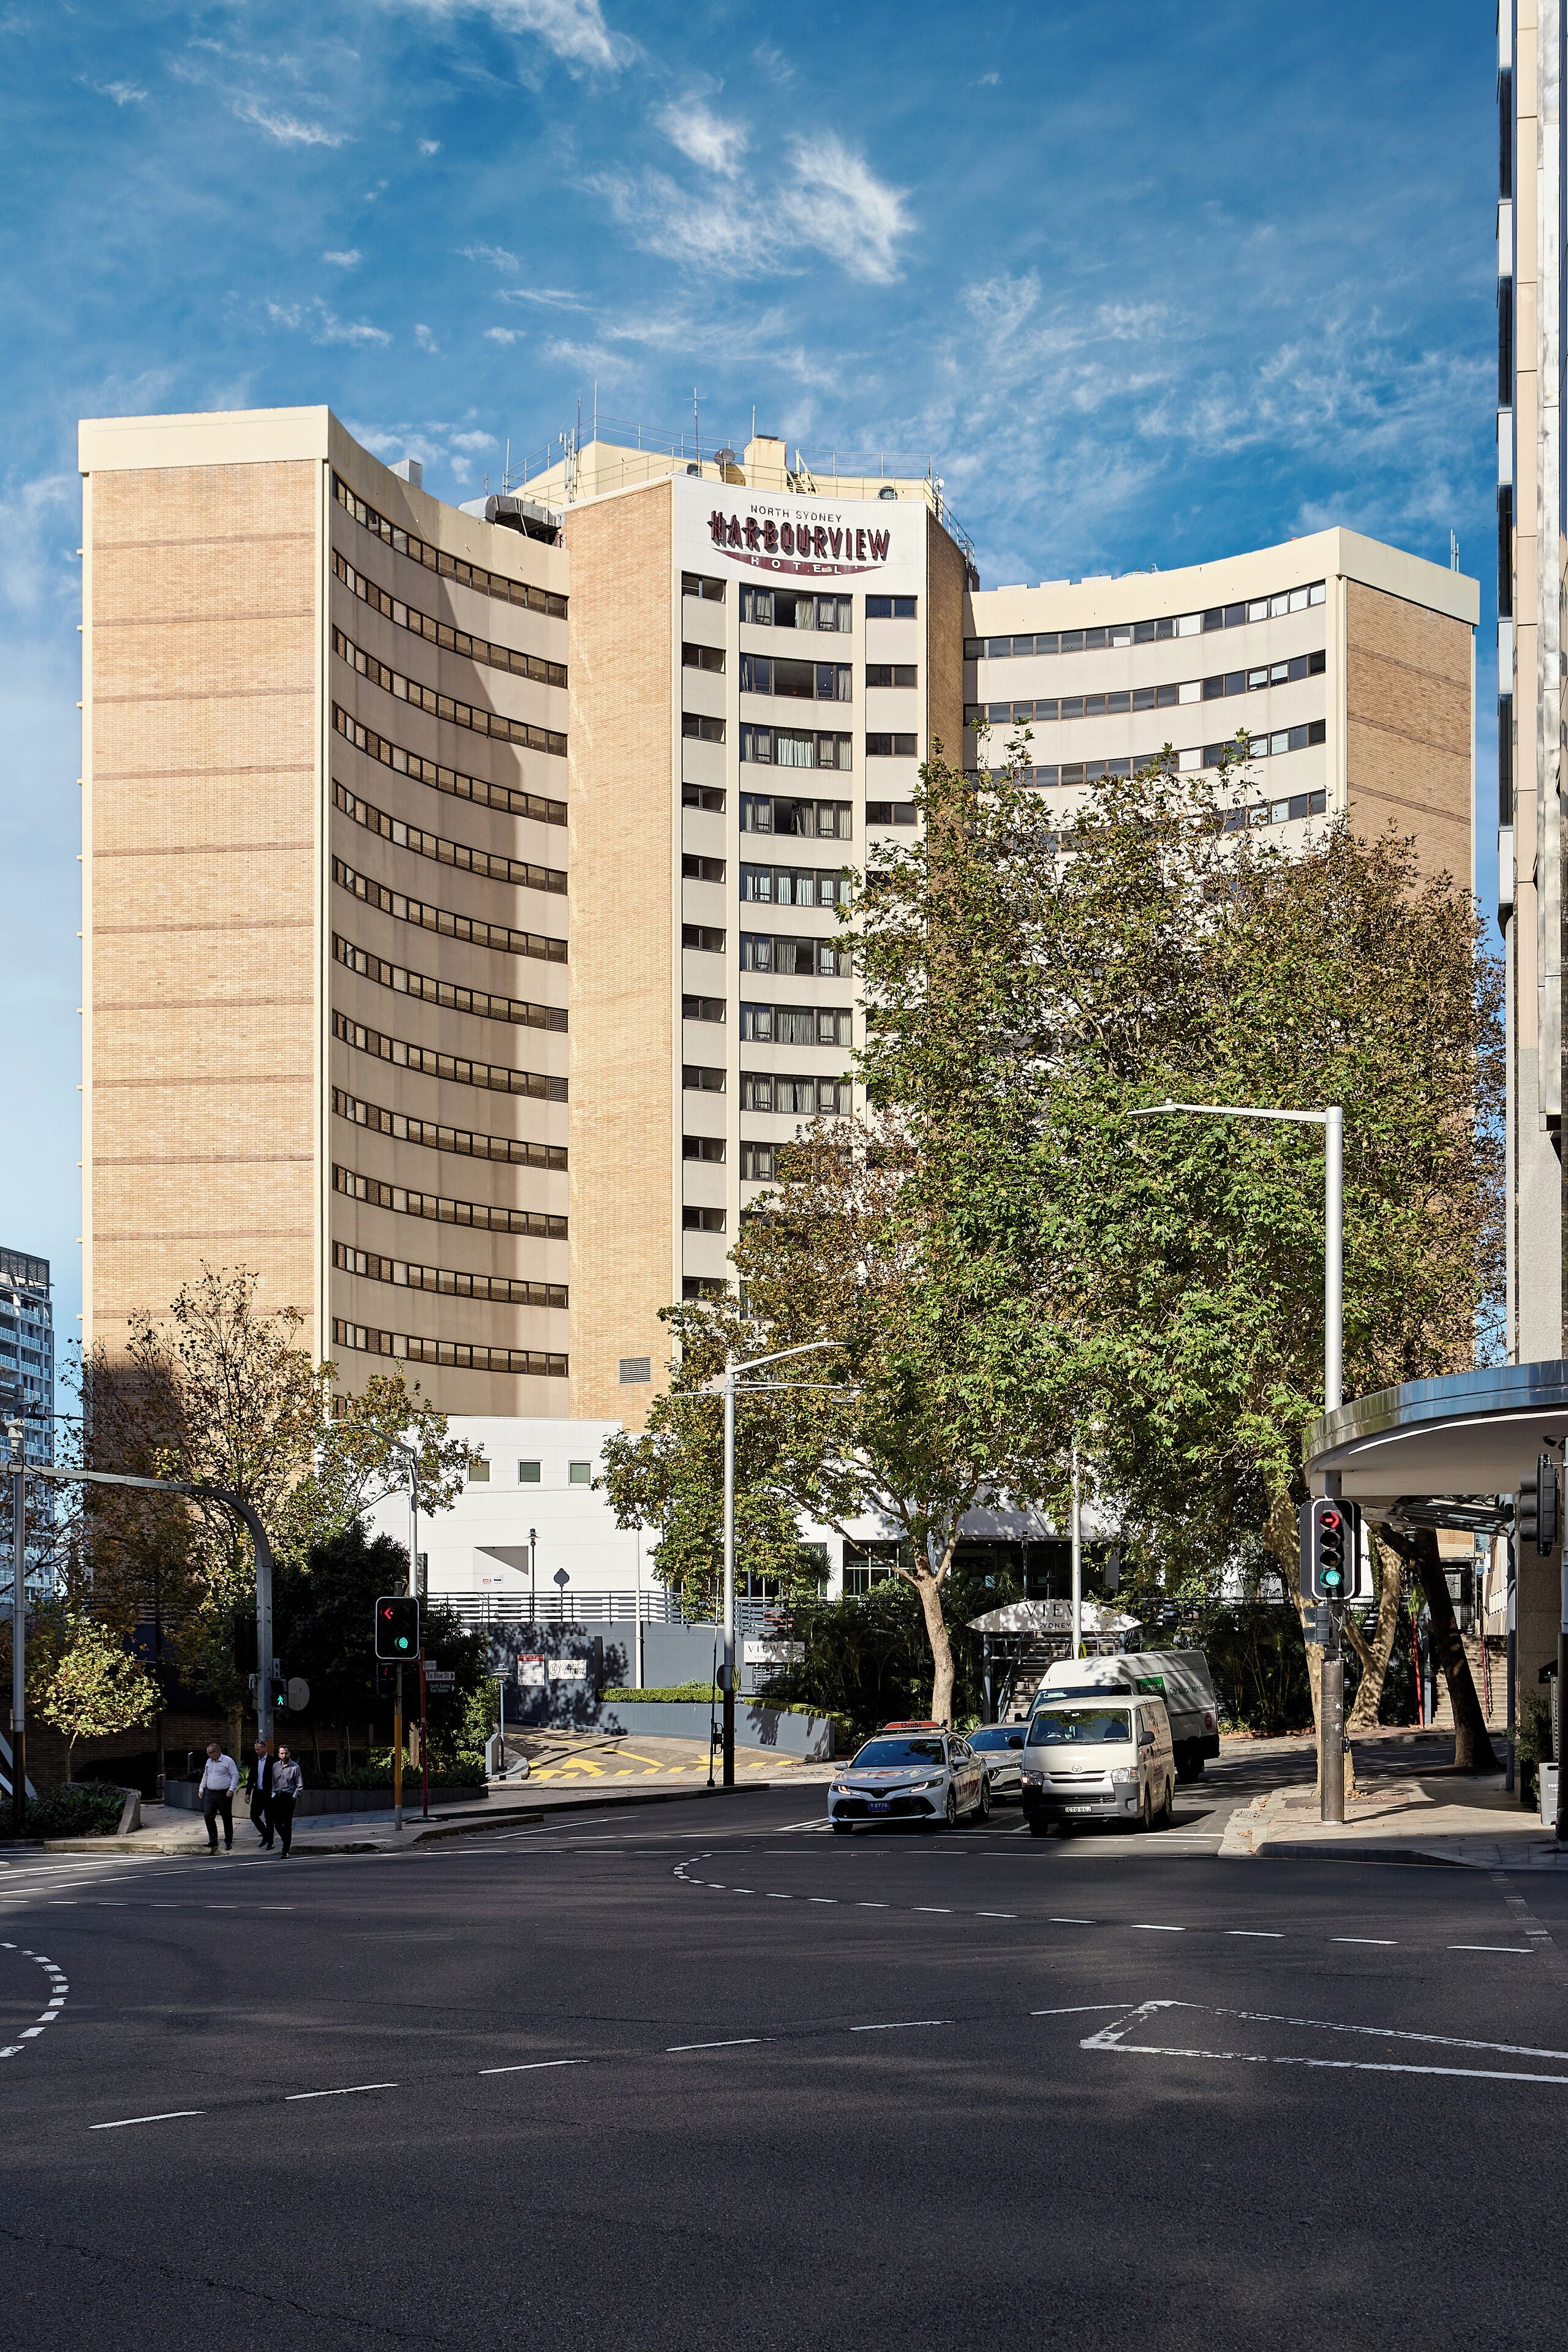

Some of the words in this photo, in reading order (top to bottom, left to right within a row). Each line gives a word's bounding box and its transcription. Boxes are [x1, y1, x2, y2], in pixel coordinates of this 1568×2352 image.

[750, 504, 790, 518] NORTH
[796, 510, 842, 523] SYDNEY
[707, 510, 891, 561] HARBOURVIEW
[751, 556, 842, 575] HOTEL
[1140, 1683, 1162, 1693] Europcar
